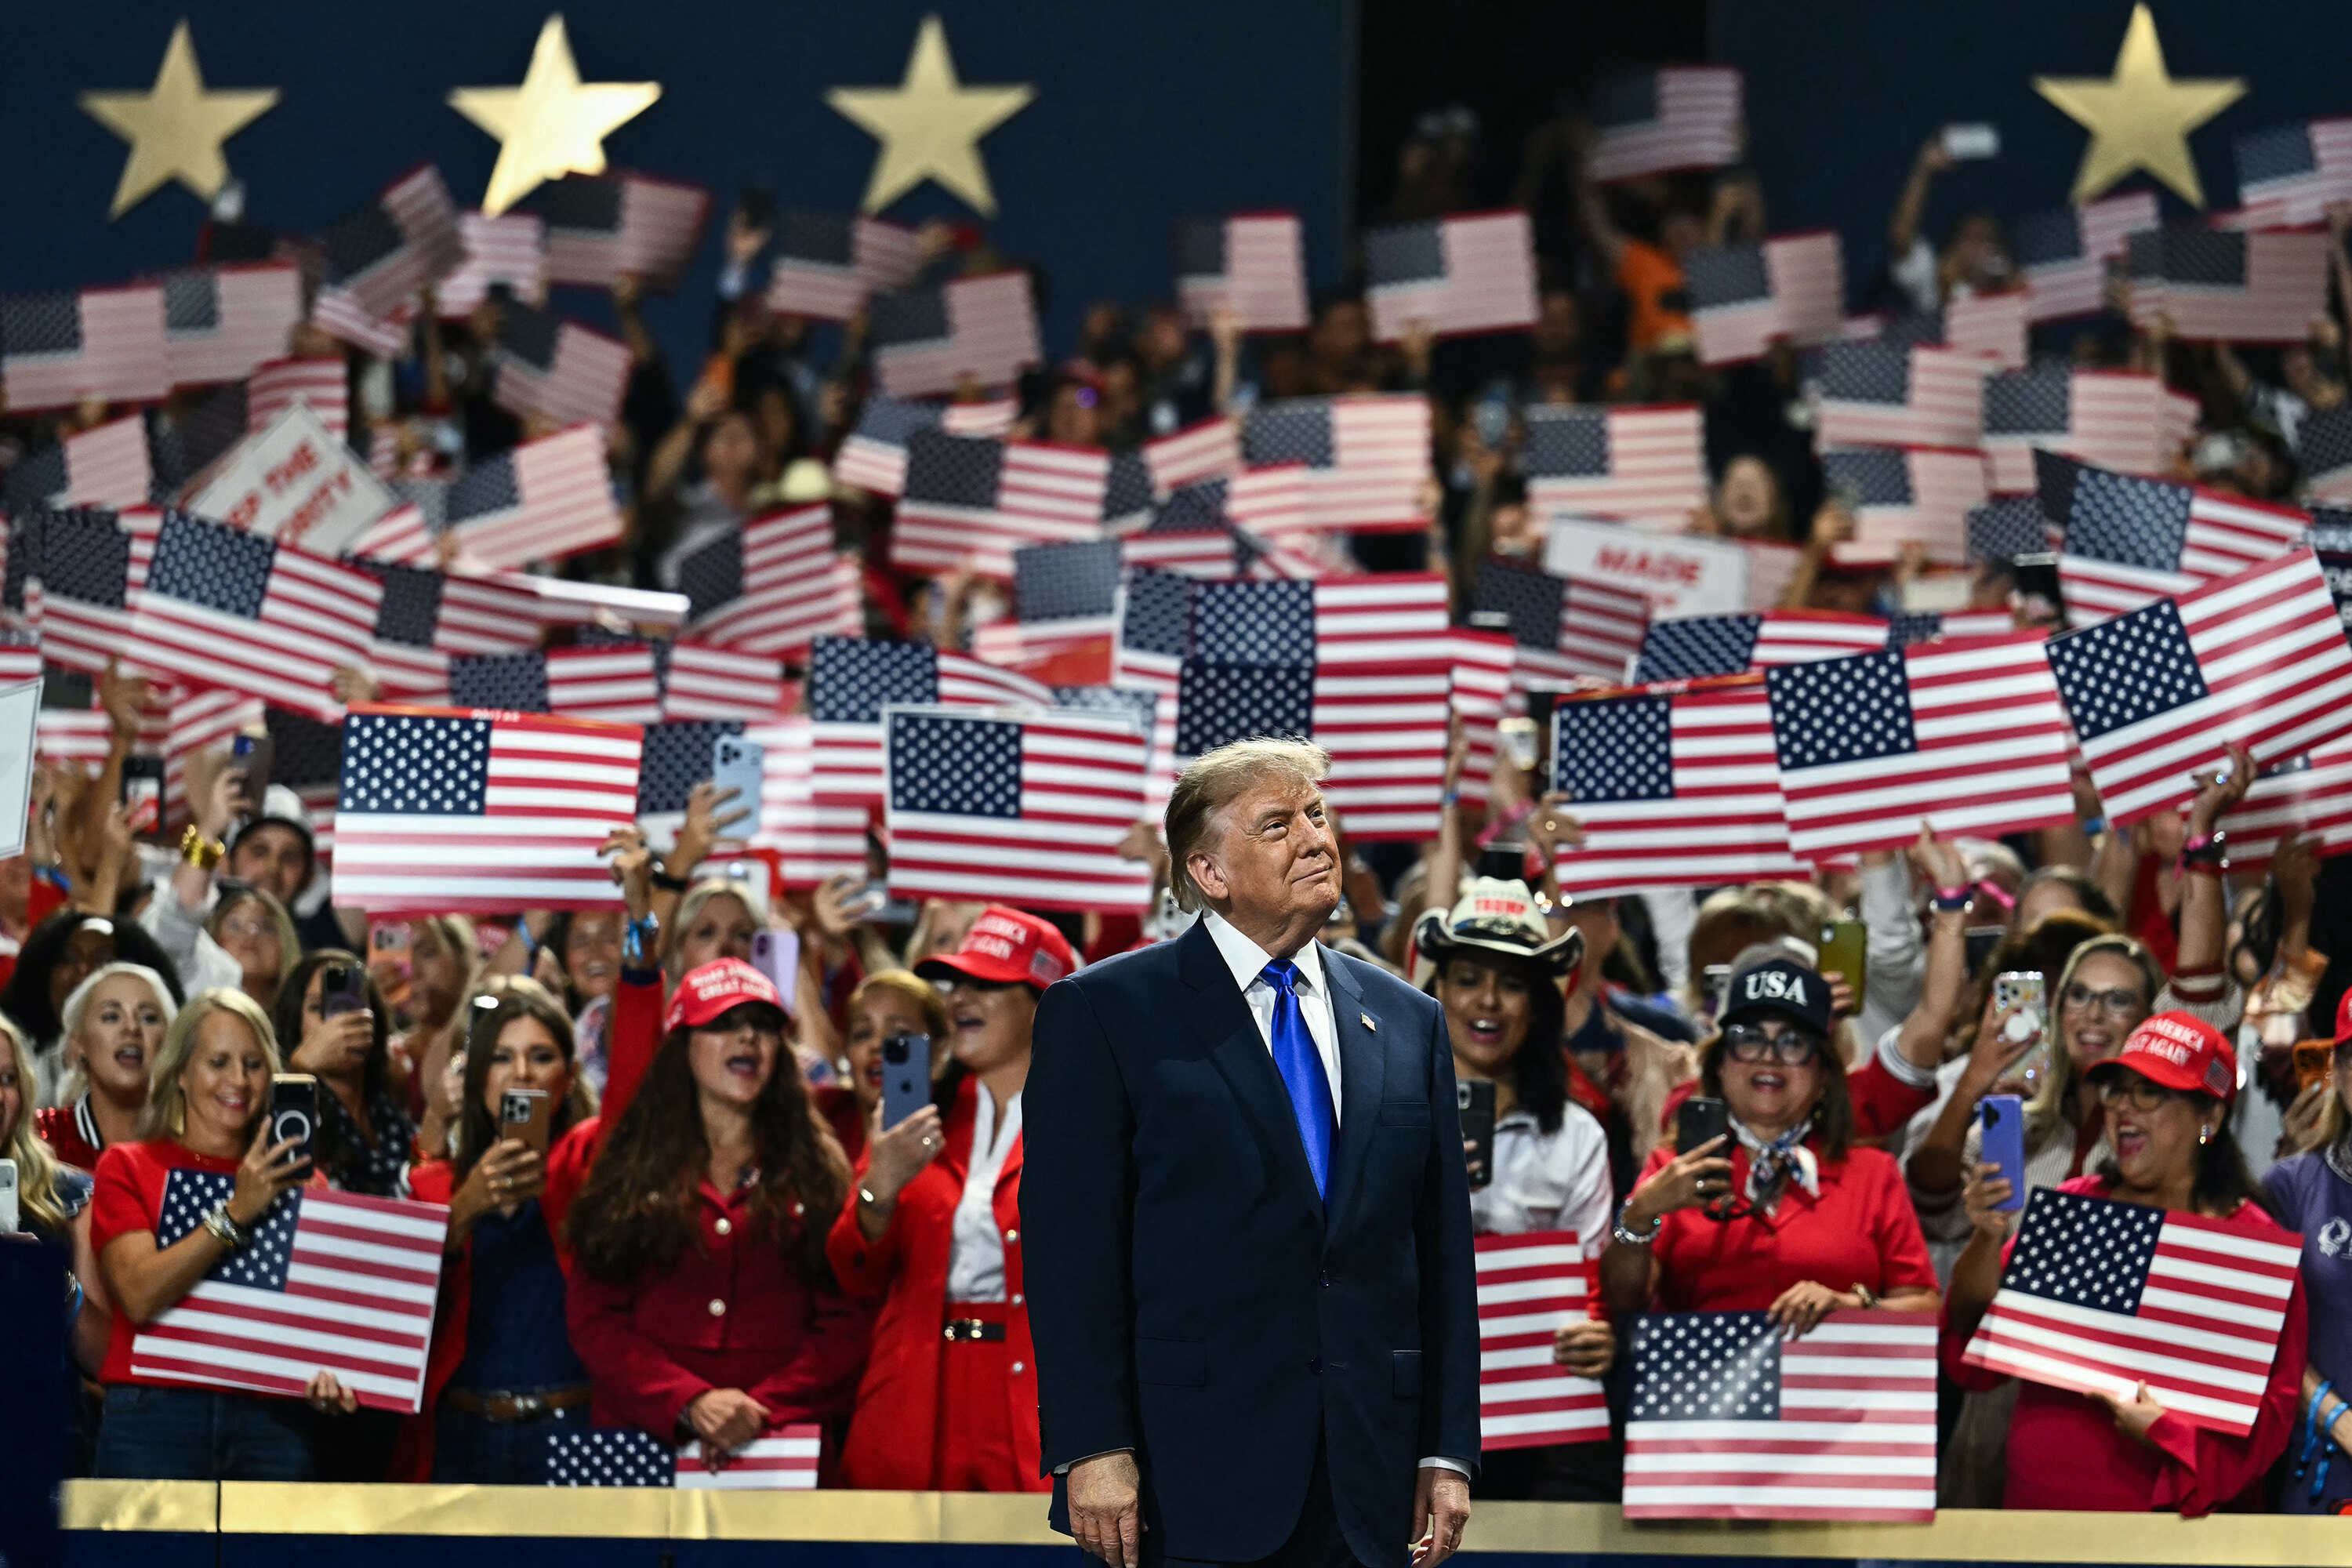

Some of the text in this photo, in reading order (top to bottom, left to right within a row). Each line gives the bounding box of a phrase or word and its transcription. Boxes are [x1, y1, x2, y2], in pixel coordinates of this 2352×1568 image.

[264, 440, 319, 497] THE
[1595, 544, 1704, 586] MADE
[1475, 898, 1526, 916] TRUMP
[1745, 971, 1808, 1007] USA
[2145, 1036, 2191, 1066] AGAIN
